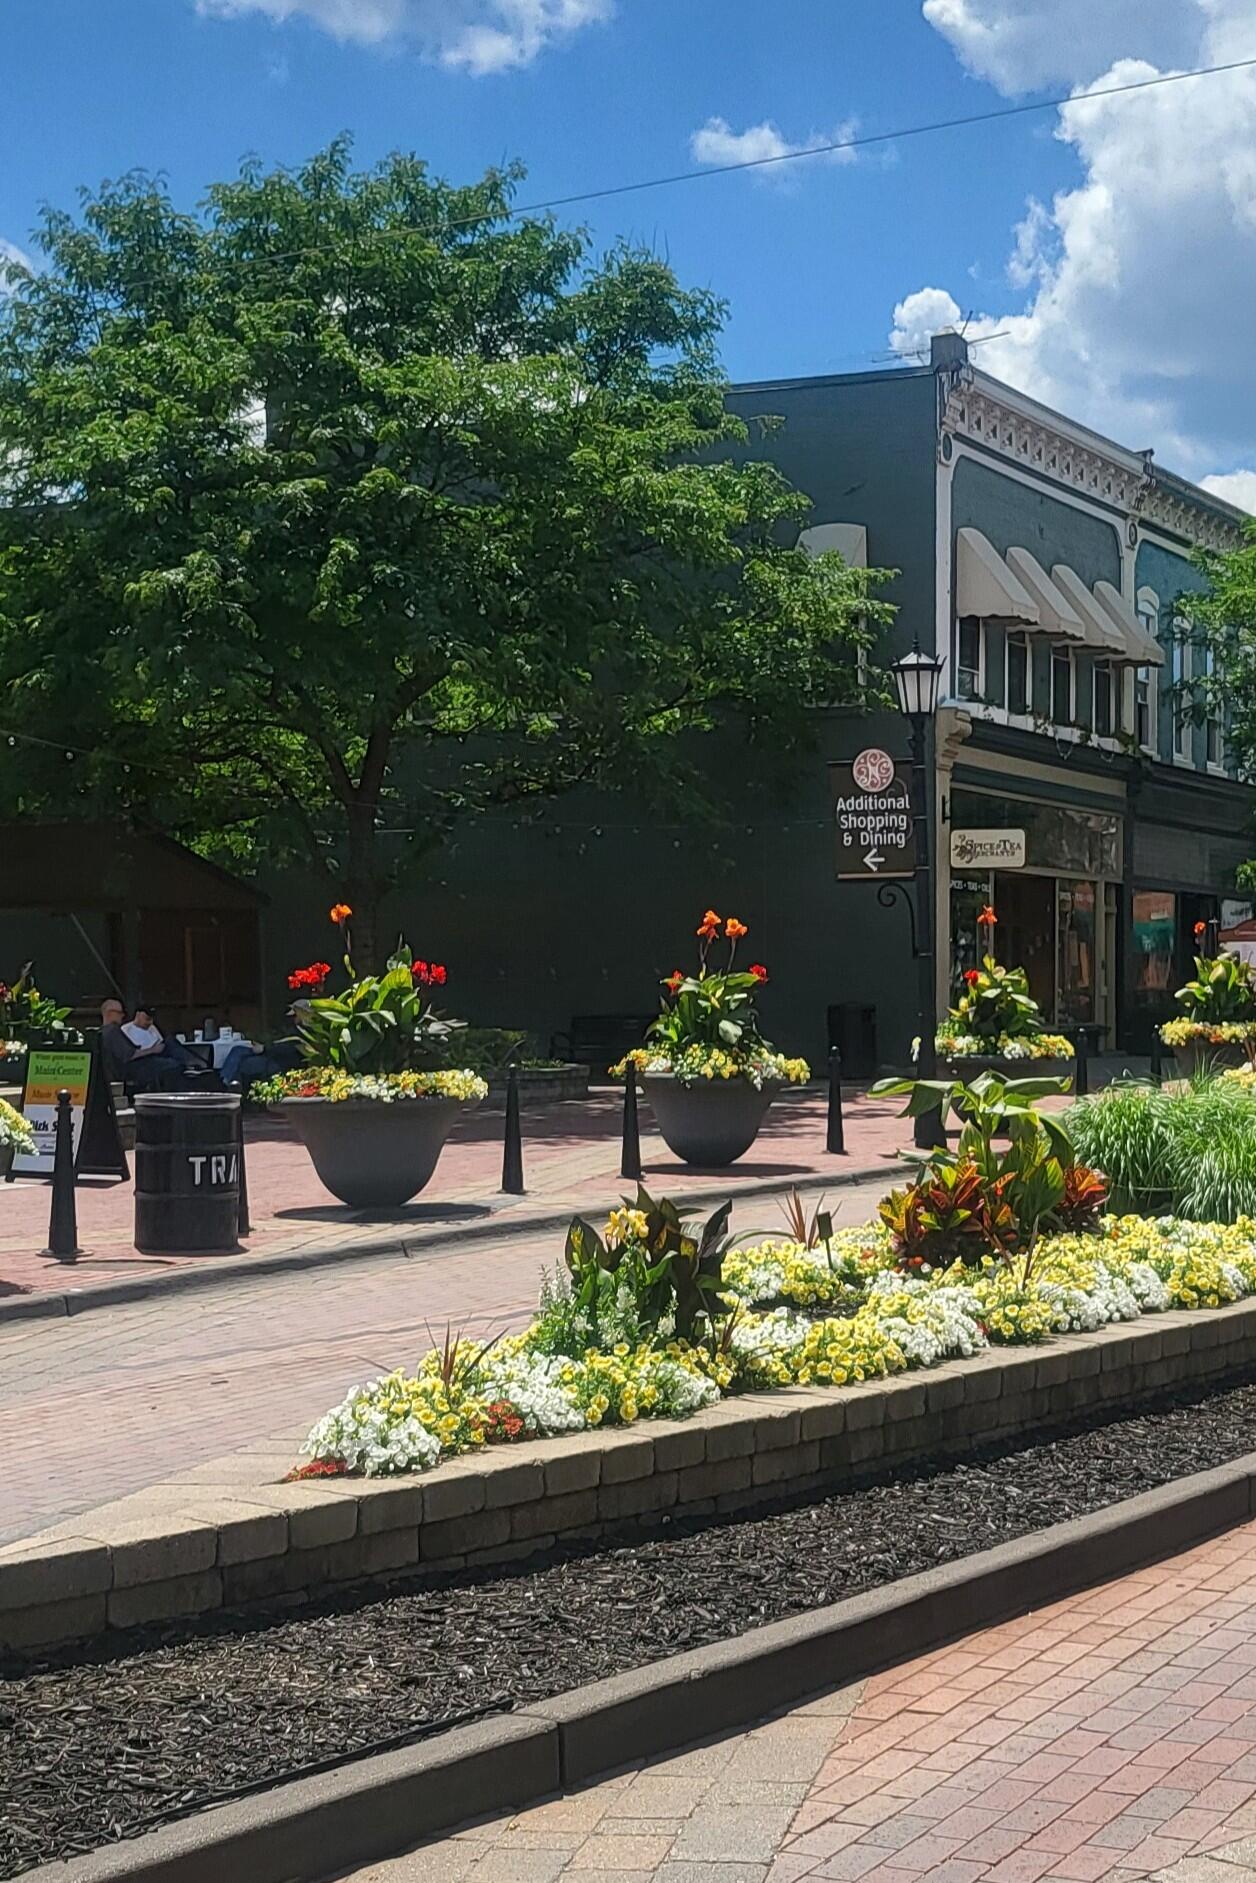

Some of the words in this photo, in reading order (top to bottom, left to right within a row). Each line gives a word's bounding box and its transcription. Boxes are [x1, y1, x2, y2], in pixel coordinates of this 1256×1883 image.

[837, 794, 910, 811] Additional
[840, 812, 907, 832] Shopping
[843, 832, 852, 846] &
[860, 830, 906, 848] Dining
